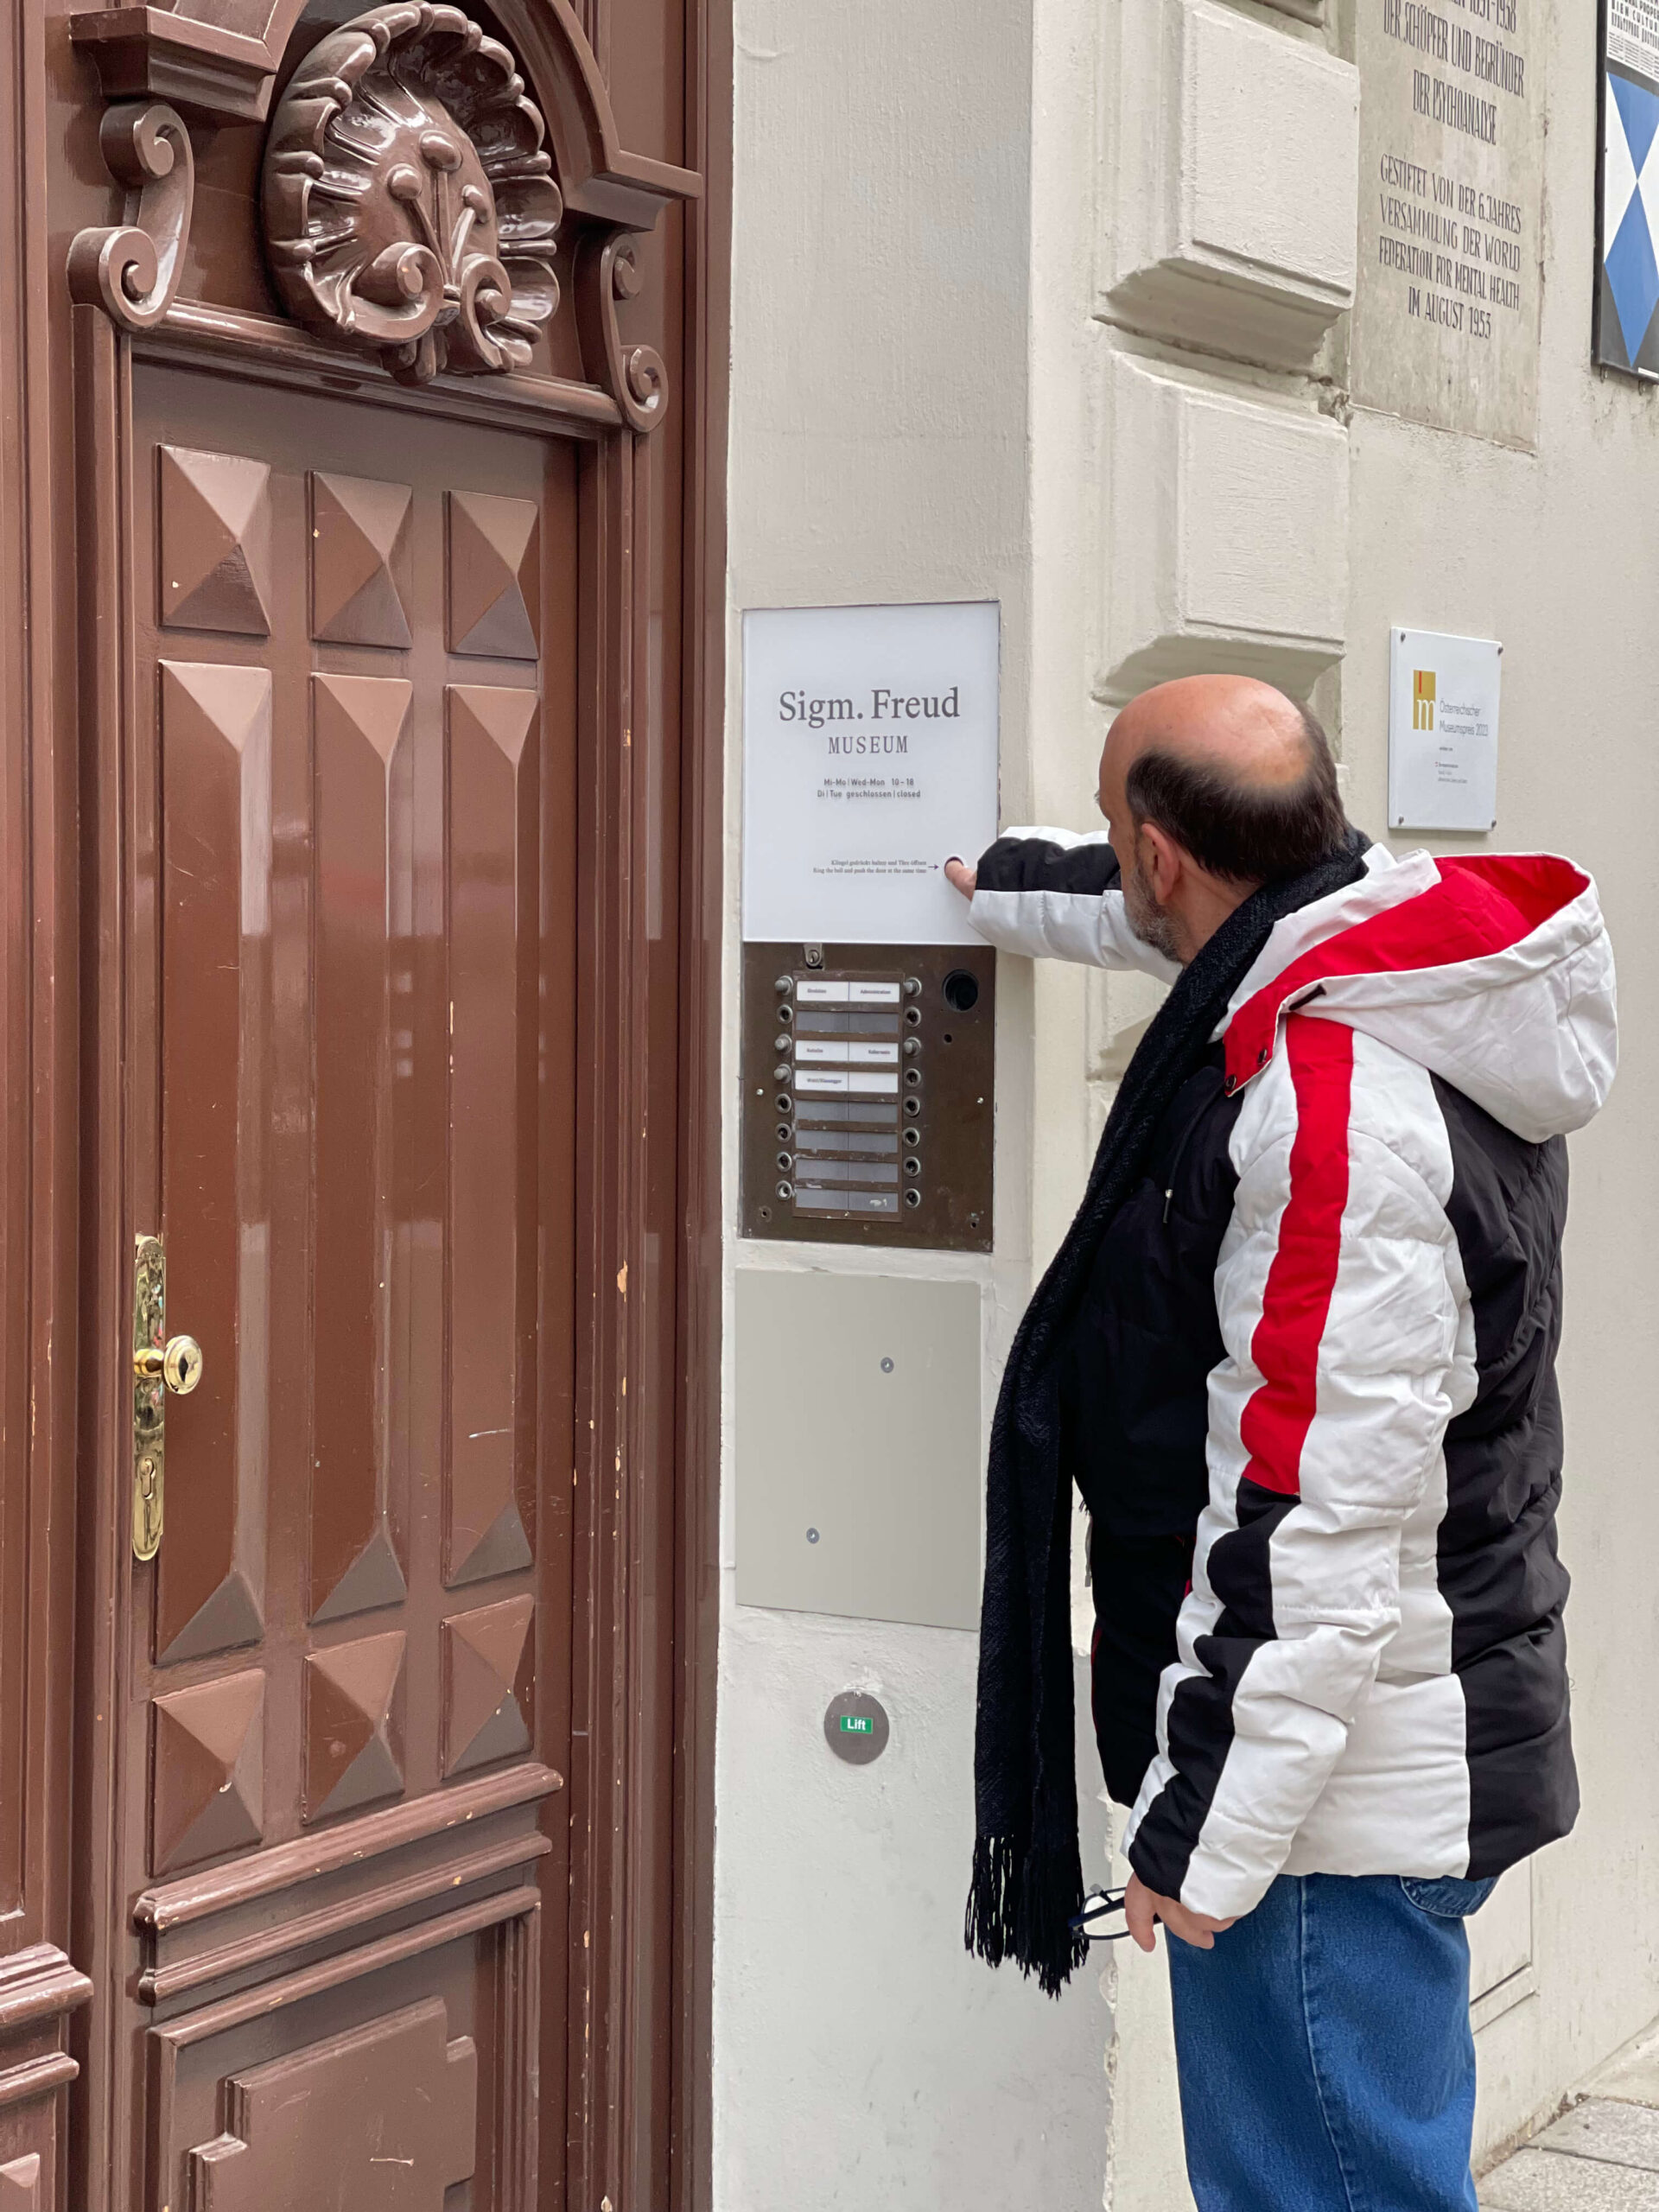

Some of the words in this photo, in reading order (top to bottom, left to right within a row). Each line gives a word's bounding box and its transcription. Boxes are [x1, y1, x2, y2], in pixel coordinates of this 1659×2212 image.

[1383, 0, 1402, 40] DER
[1404, 2, 1449, 62] SCHÖPFER
[1452, 23, 1471, 73] UND
[1475, 35, 1524, 99] BEGRÜNDER
[1413, 69, 1431, 117] DER
[1433, 78, 1497, 145] PSYCHOANALYSE
[1380, 153, 1427, 198] GESTIFTET
[1432, 173, 1454, 208] VON
[1459, 184, 1476, 218] DER
[1380, 194, 1458, 250] VERSAMMLUNG
[1463, 226, 1481, 258] DER
[1484, 233, 1521, 273] WORLD
[1379, 235, 1433, 282] FEDERATION
[1436, 255, 1452, 289] FOR
[1455, 261, 1487, 300] MENTAL
[1490, 275, 1520, 311] HEALTH
[1408, 286, 1421, 318] IM
[1425, 292, 1465, 331] AUGUST
[1469, 307, 1491, 339] 1953
[779, 690, 863, 728] Sigm.
[871, 686, 961, 720] Freud
[828, 735, 908, 755] MUSEUM
[847, 1718, 866, 1731] Lift
